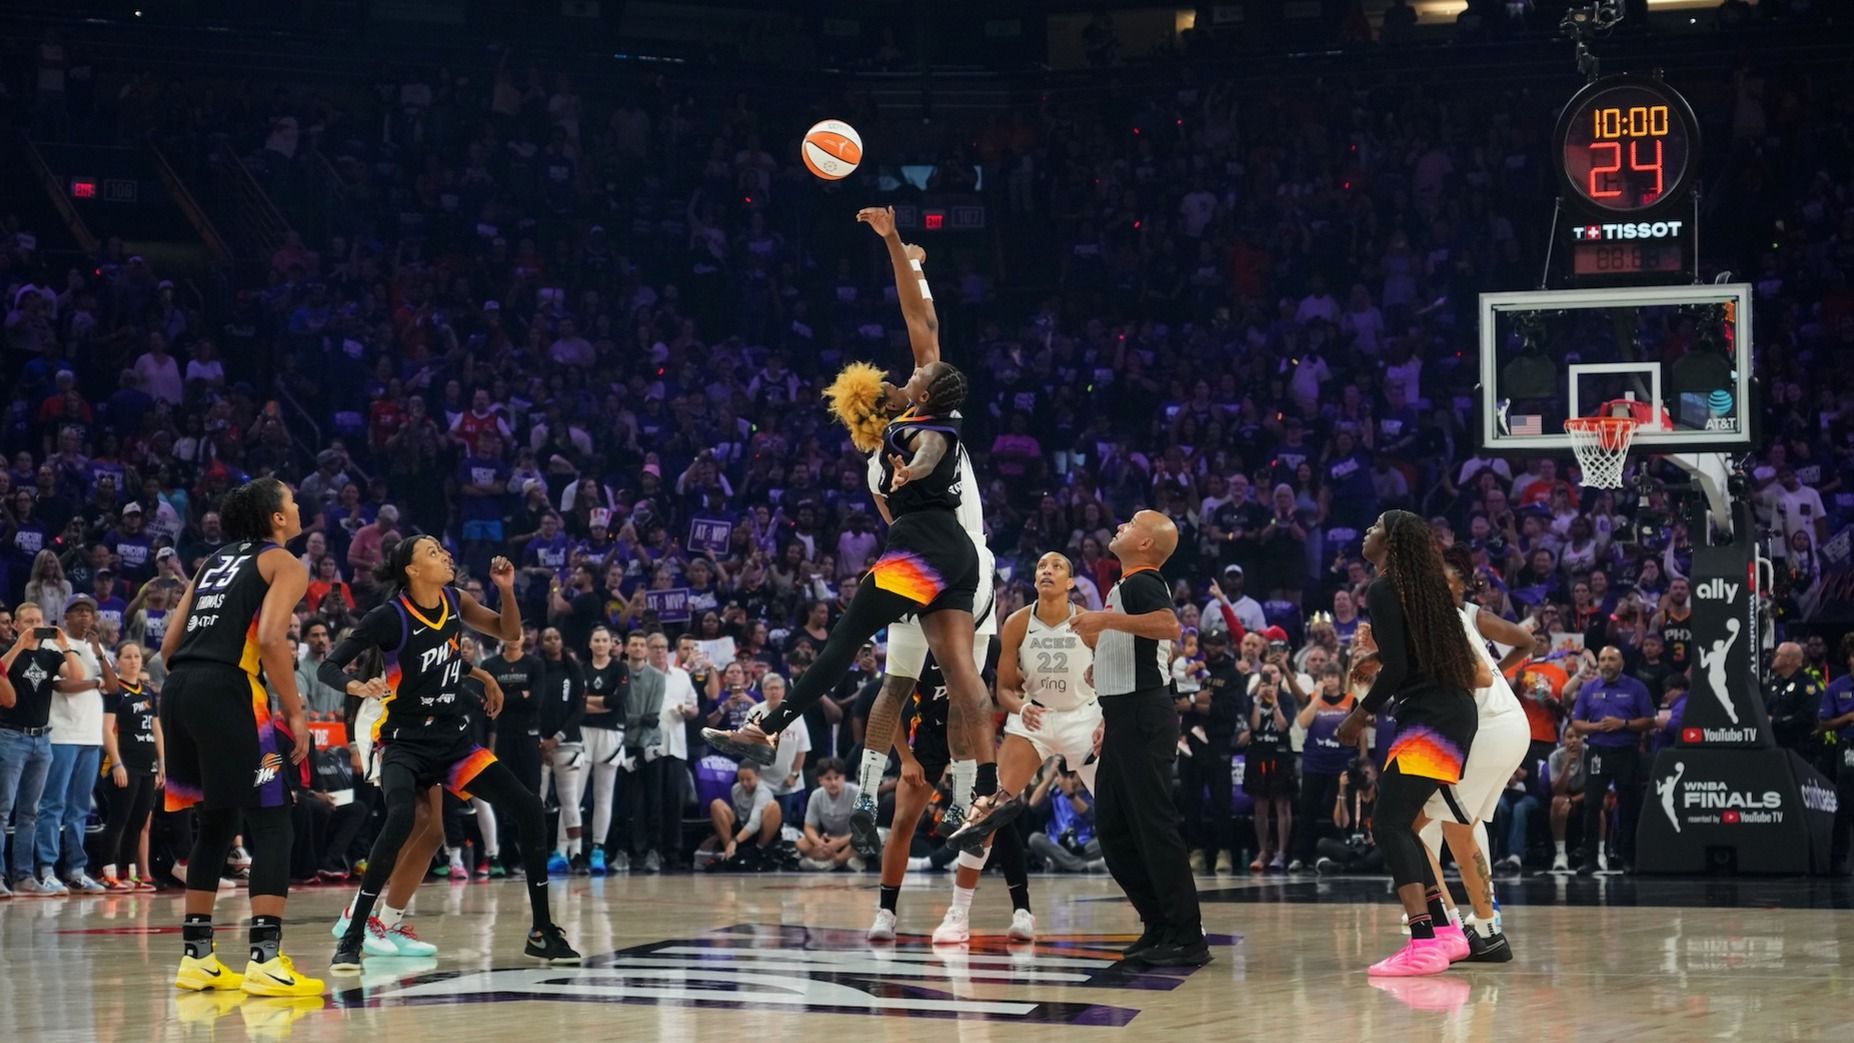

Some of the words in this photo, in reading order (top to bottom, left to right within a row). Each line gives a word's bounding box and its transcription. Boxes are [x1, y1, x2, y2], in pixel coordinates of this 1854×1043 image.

[1594, 106, 1669, 138] 10:00
[1588, 139, 1664, 198] 24
[1603, 221, 1683, 240] TISSOT
[1705, 418, 1736, 431] AT&T
[197, 554, 252, 591] 25
[1696, 578, 1739, 604] ally
[665, 593, 686, 610] MVP
[1030, 637, 1076, 649] ACES
[1664, 628, 1692, 641] PHX
[420, 632, 460, 672] PHX
[1673, 642, 1685, 661] 3
[1037, 651, 1069, 673] 22
[441, 658, 461, 688] 14
[1041, 677, 1067, 692] ring
[1703, 728, 1742, 742] YouTube
[1743, 728, 1757, 742] TV
[1684, 781, 1728, 791] WNBA
[1684, 791, 1782, 808] FINALS
[1713, 814, 1720, 824] by
[1740, 811, 1771, 823] YouTube
[1772, 811, 1783, 823] TV
